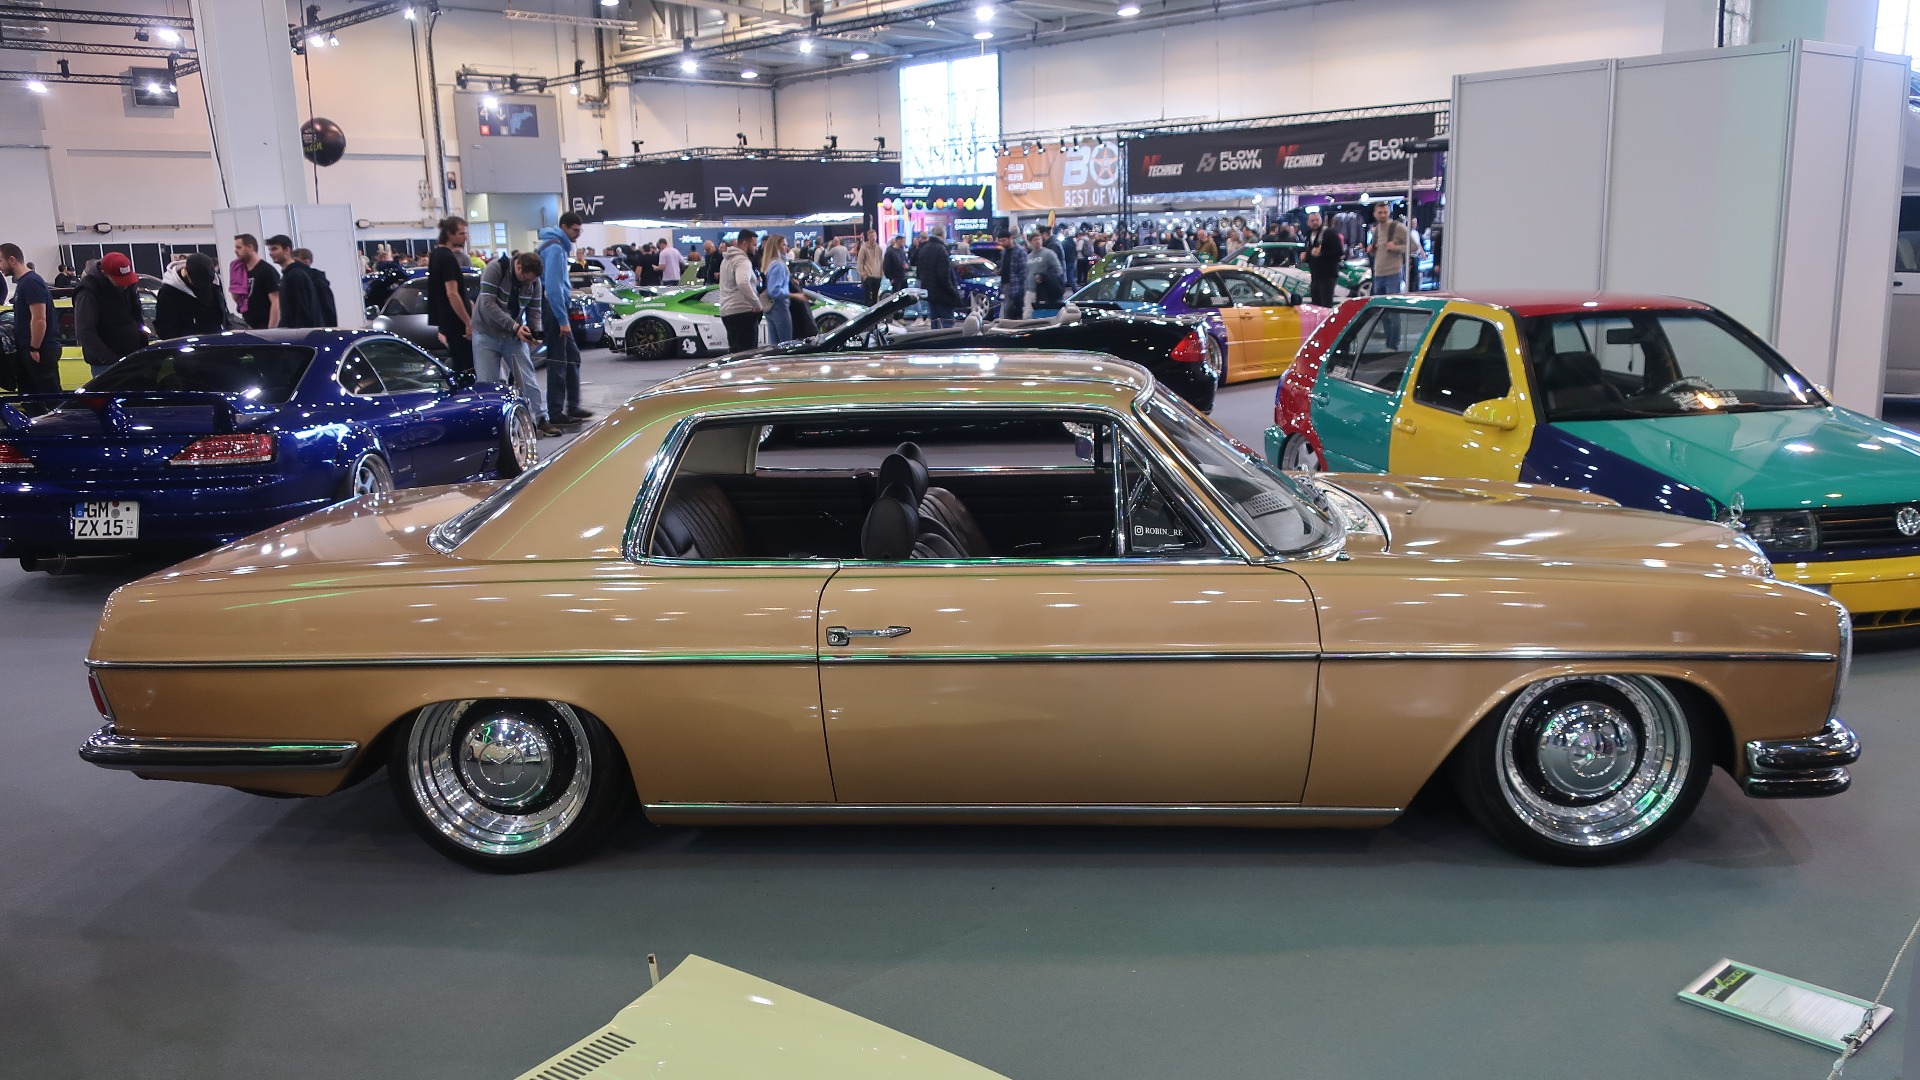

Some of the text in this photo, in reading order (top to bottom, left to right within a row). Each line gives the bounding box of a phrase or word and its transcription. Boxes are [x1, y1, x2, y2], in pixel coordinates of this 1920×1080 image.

[1220, 149, 1259, 161] FLOW
[1283, 153, 1325, 169] TECHNIKS
[1148, 163, 1183, 177] TECHNIKS
[1220, 159, 1262, 171] DOWN
[663, 190, 697, 211] XPEL
[714, 186, 769, 207] PWF
[1064, 188, 1089, 207] BEST
[1092, 187, 1106, 205] OF
[572, 195, 604, 216] PWF
[87, 502, 109, 518] GM
[78, 520, 123, 536] ZX 15
